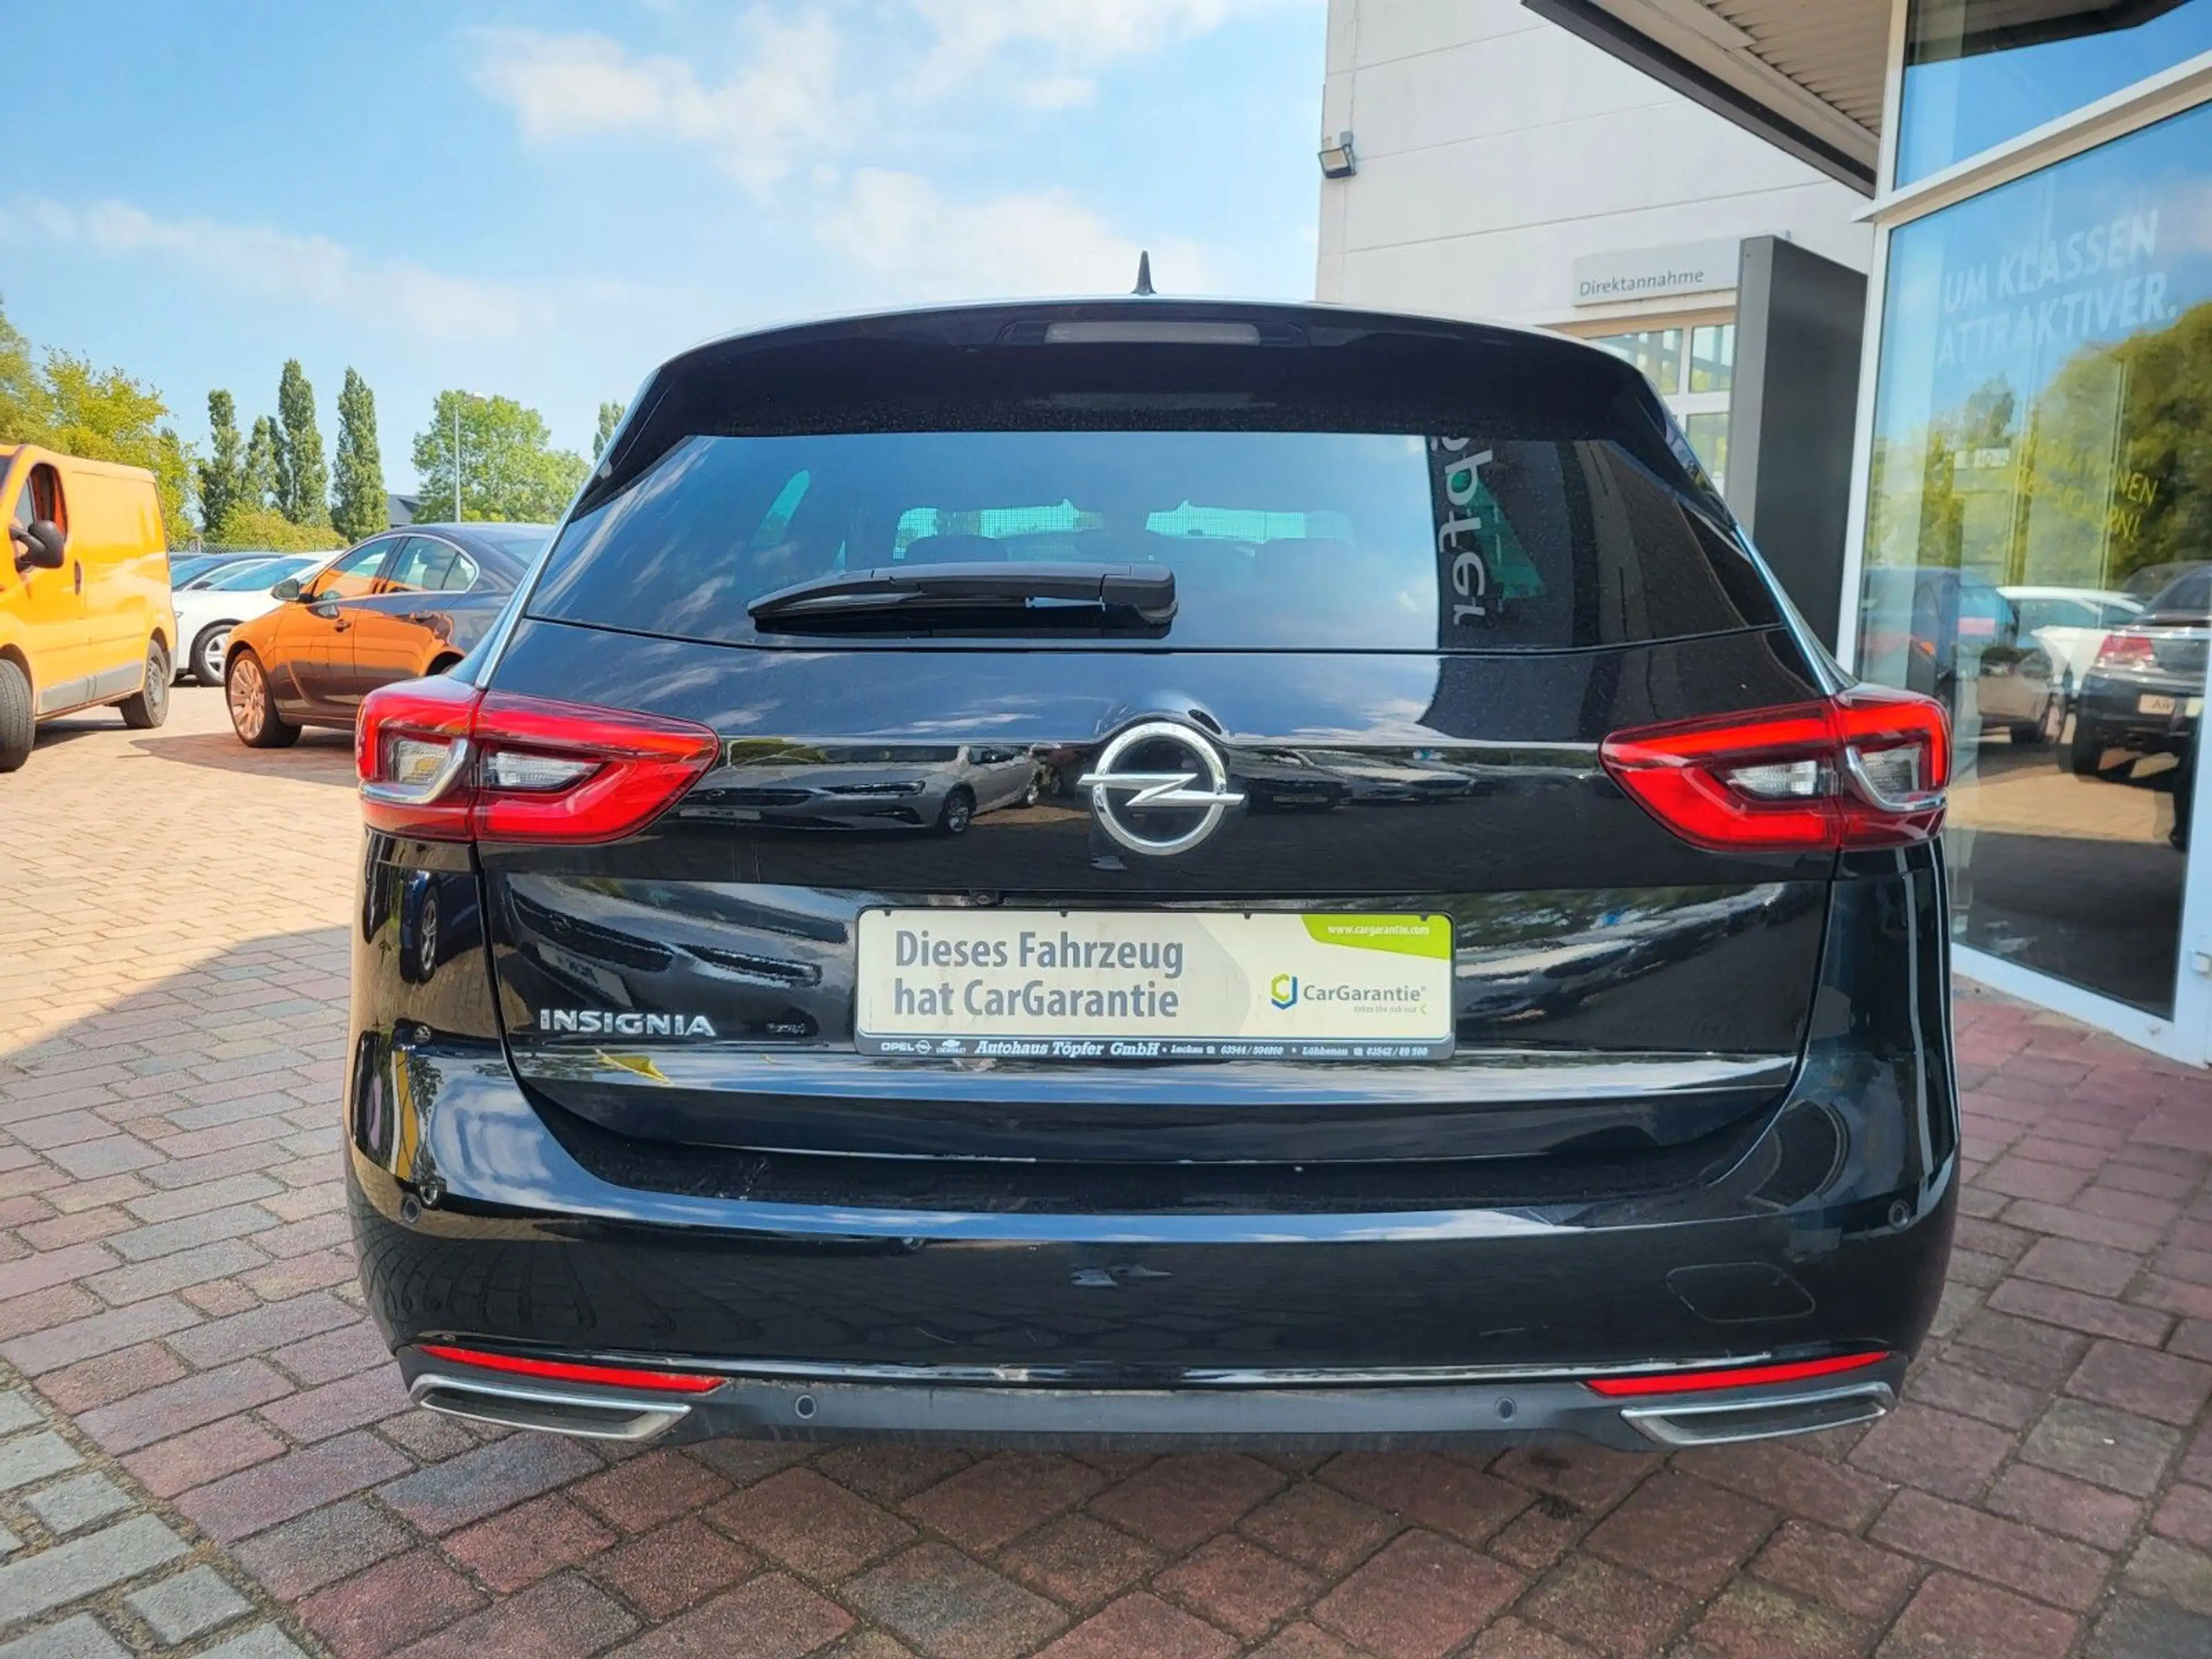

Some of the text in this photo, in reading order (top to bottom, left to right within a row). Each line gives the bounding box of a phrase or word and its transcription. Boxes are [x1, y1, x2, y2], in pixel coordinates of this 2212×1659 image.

[1945, 210, 2157, 312] UM KLASSEN
[1579, 268, 1705, 297] Direktannahme
[895, 930, 1184, 979] Dieses Fahrzeug
[893, 978, 1179, 1018] hat CarGarantie
[540, 1009, 717, 1036] INSIGNIA
[881, 1041, 915, 1051] OPEL
[975, 1040, 1048, 1055] Autohaus
[1051, 1040, 1104, 1058] Töpfer
[1109, 1040, 1160, 1056] GmbH
